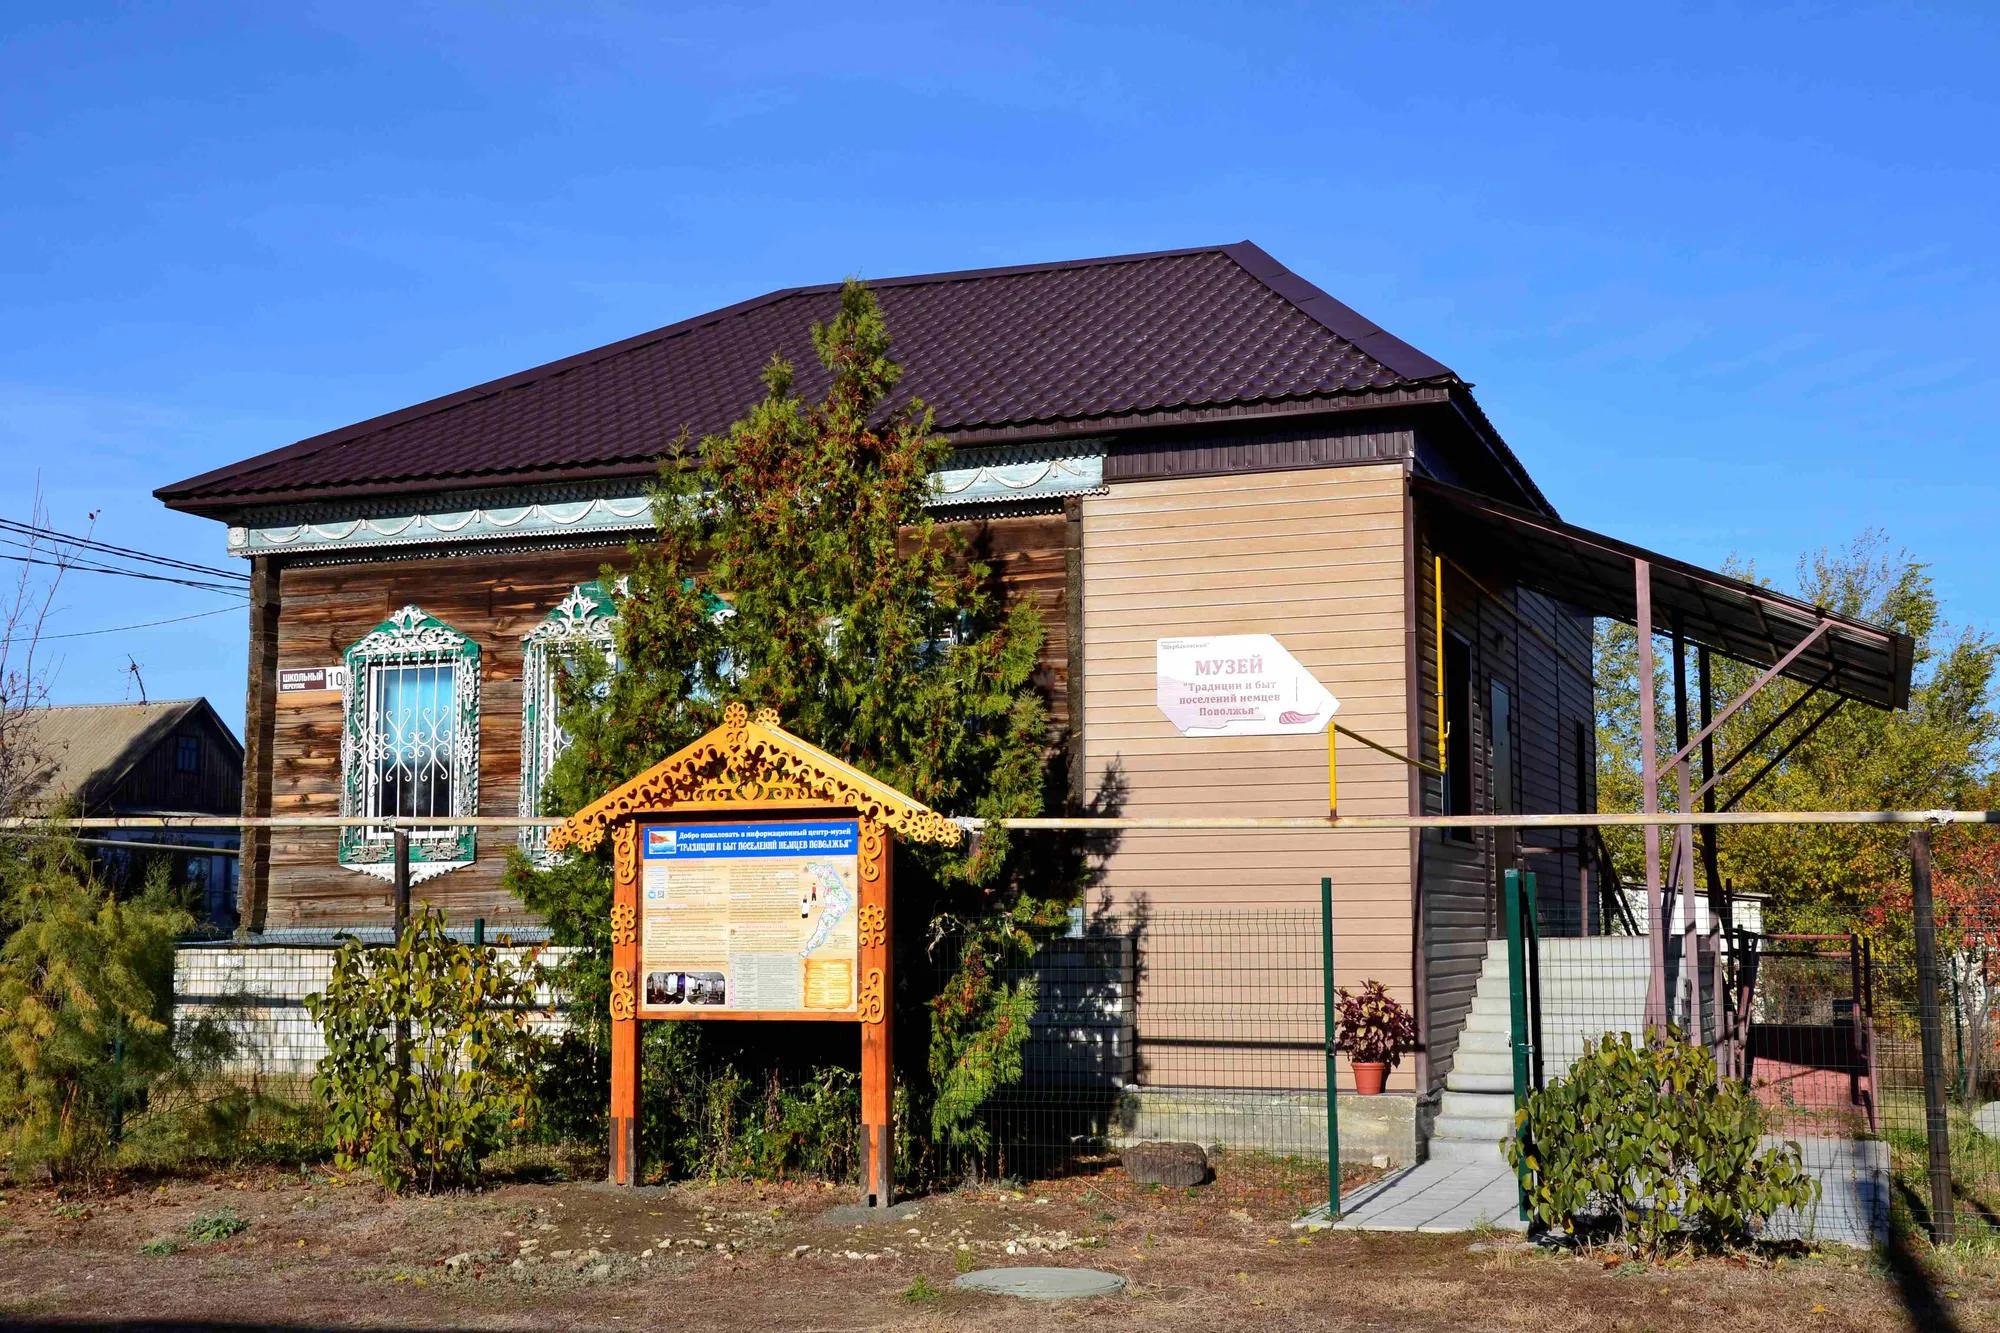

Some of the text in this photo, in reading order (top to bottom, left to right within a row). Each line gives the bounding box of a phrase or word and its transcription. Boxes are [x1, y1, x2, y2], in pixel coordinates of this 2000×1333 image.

[1195, 655, 1263, 676] МУЗЕЙ
[283, 671, 323, 682] ШКОЛЬНЫЙ
[1183, 680, 1277, 693] "Традиции и быт
[1179, 693, 1281, 705] поселений немцев
[1199, 706, 1260, 717] Поволжья"
[679, 832, 699, 840] Добро
[700, 831, 740, 839] пожаловать
[746, 829, 806, 838] информационный
[808, 827, 851, 837] центр-музей
[722, 841, 737, 851] БЫТ
